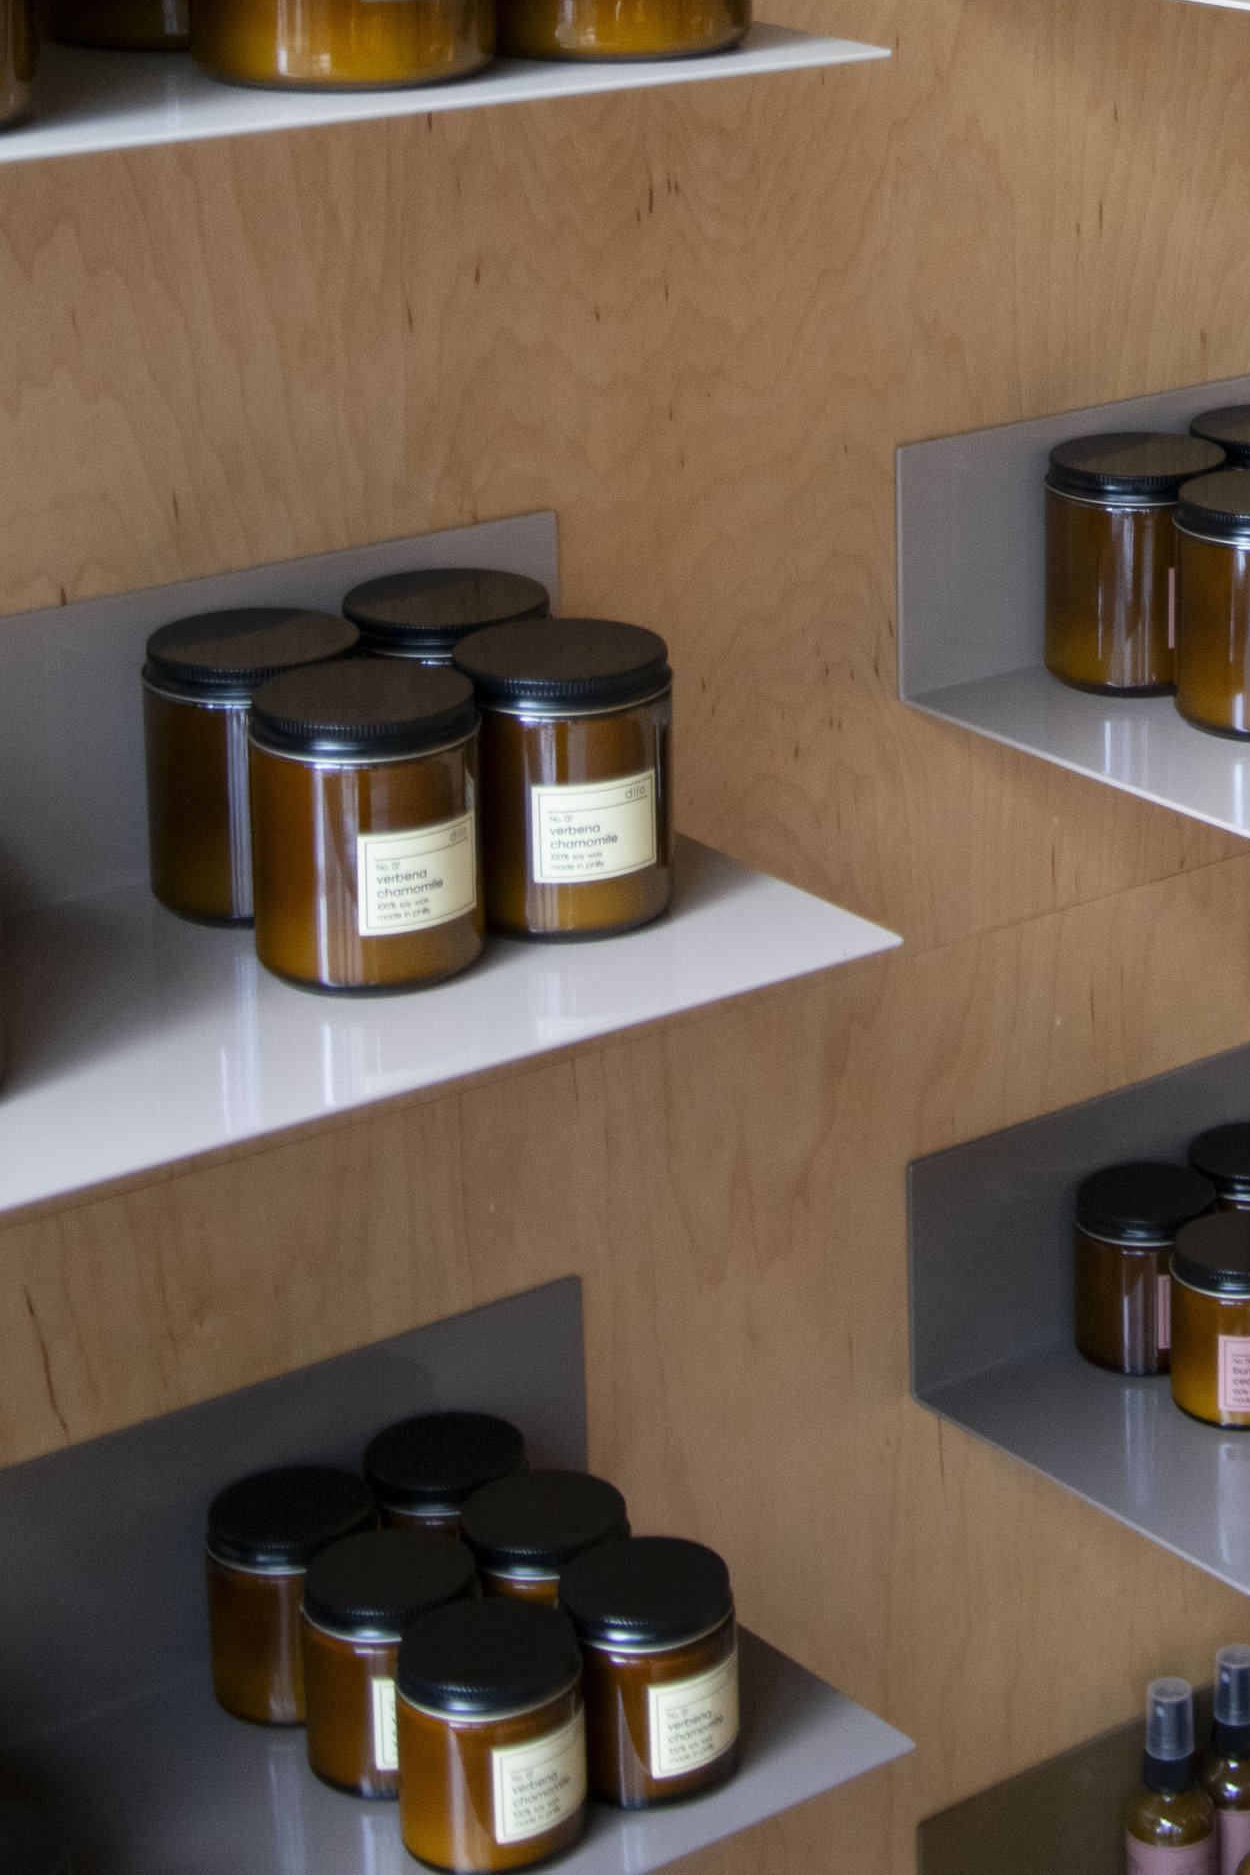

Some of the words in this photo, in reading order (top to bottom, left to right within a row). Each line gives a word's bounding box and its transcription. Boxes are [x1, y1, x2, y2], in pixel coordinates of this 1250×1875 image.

[624, 784, 646, 799] dilo
[449, 826, 468, 842] dilo
[549, 824, 601, 837] verbena
[550, 834, 618, 850] chamomile
[391, 862, 401, 870] 07
[376, 869, 427, 885] verbena
[376, 878, 444, 899] chamomile
[667, 1710, 712, 1731] verbena
[512, 1771, 558, 1795] verbena
